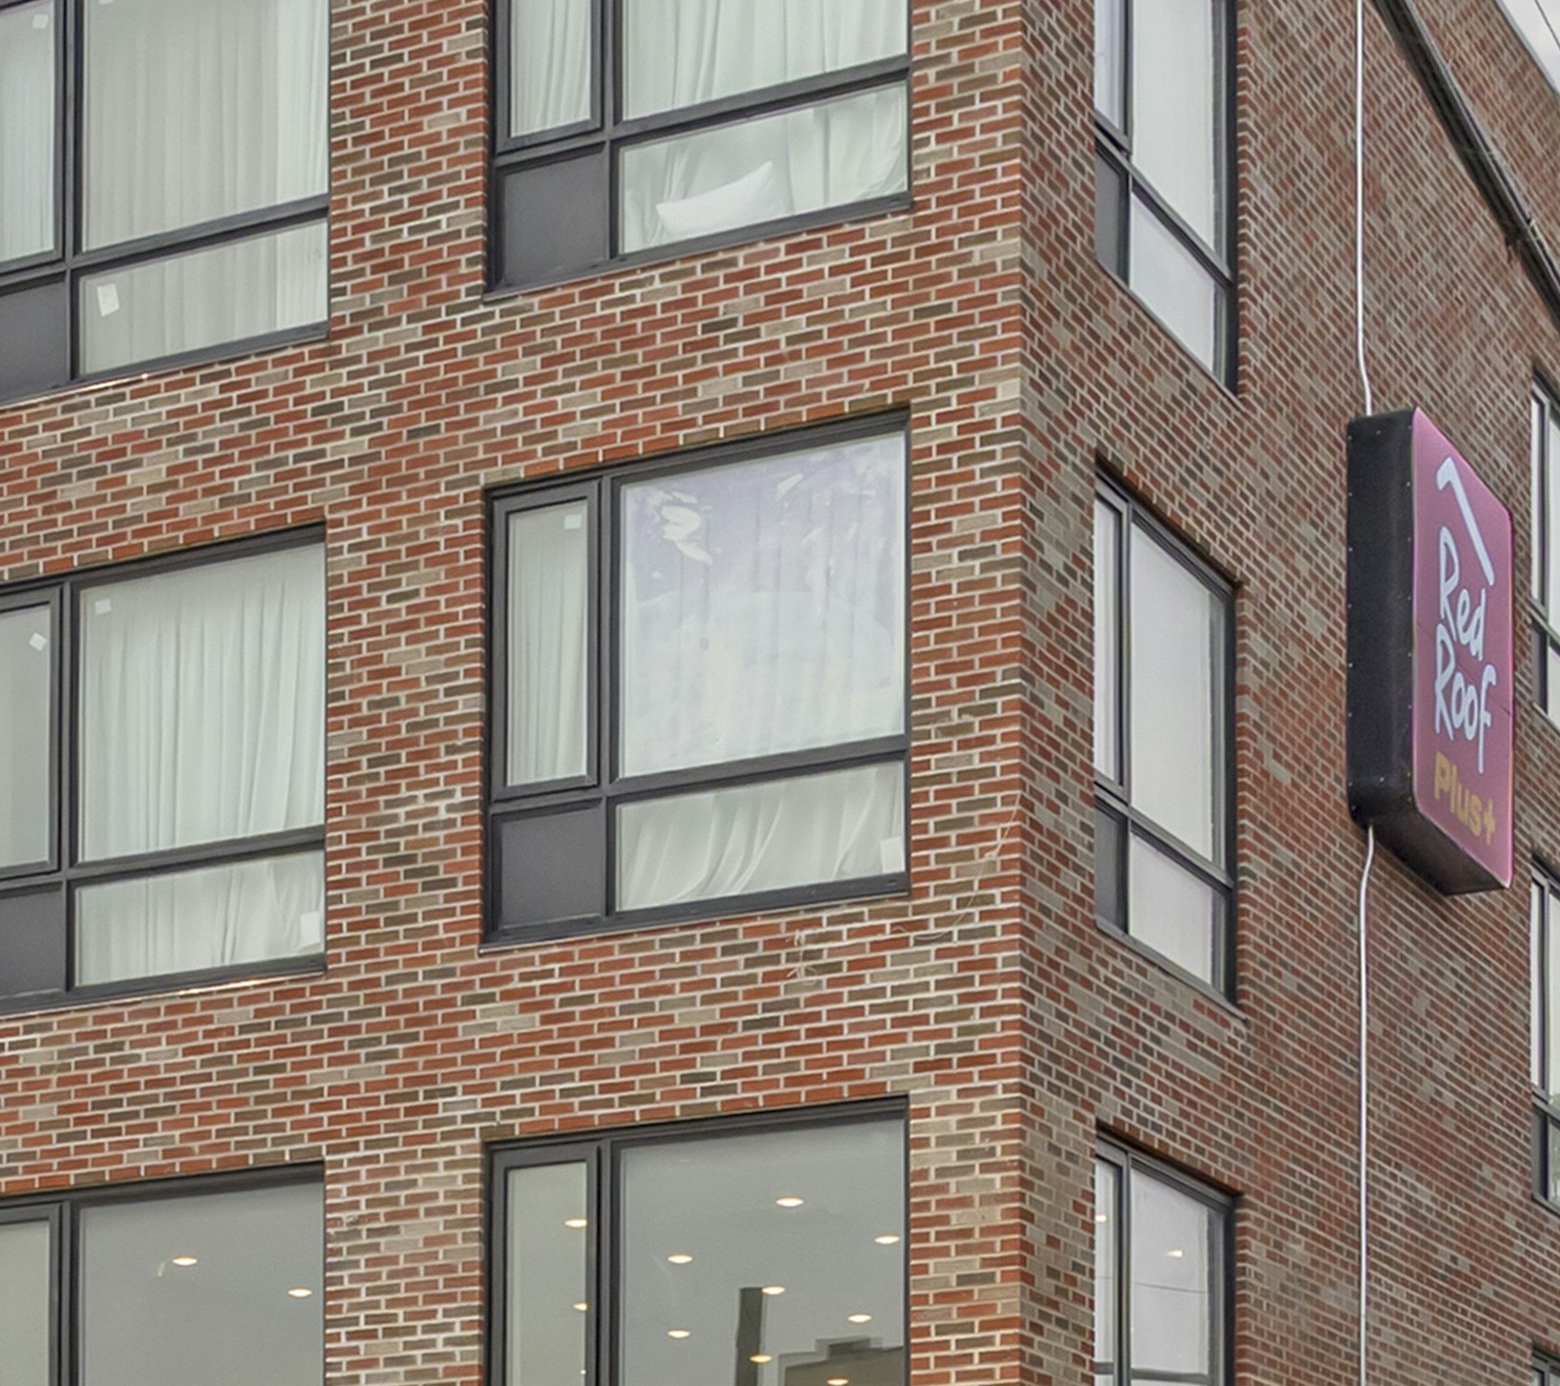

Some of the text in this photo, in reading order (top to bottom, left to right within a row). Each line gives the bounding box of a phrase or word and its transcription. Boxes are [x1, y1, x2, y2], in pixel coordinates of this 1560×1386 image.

[1438, 524, 1487, 662] Red
[1434, 622, 1497, 774] Roof
[1433, 751, 1498, 845] Plus+
